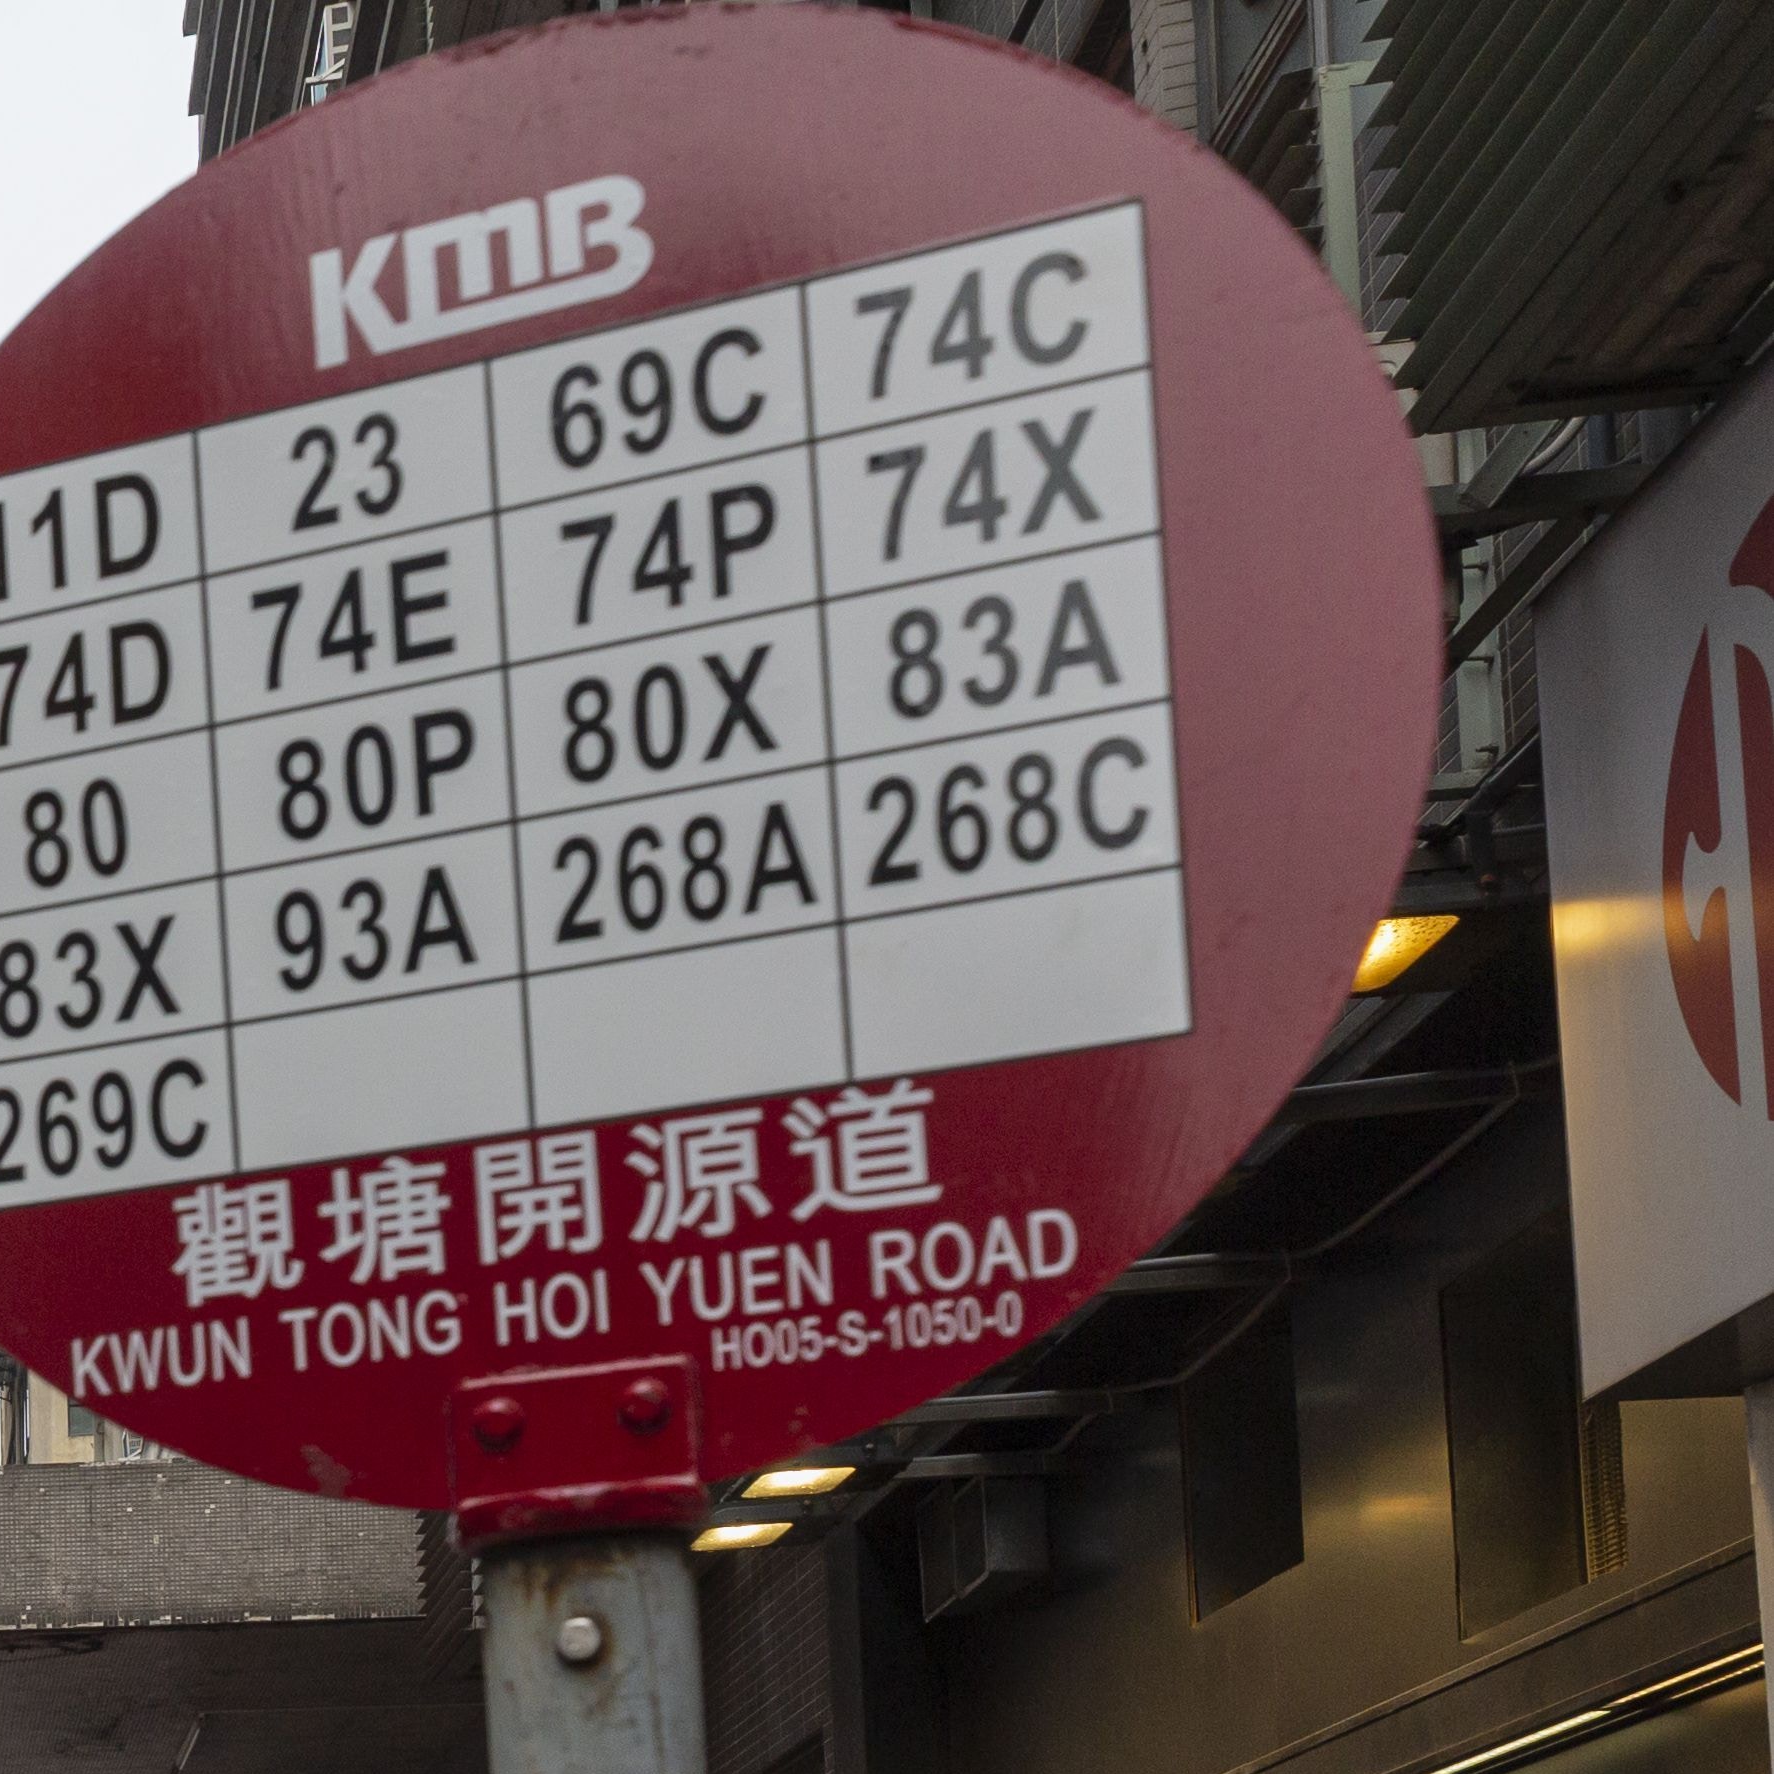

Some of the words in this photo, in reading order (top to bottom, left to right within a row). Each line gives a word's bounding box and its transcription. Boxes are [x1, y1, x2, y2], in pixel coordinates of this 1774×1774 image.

[309, 172, 655, 370] KMB
[854, 250, 1090, 403] 74C
[548, 327, 765, 470] 69C
[293, 412, 405, 535] 23
[868, 407, 1105, 563] 74X
[252, 550, 456, 693] 74E
[561, 482, 780, 626] 74P
[564, 643, 780, 784] 80X
[889, 577, 1123, 720] 83A
[24, 777, 127, 890] 80
[278, 709, 475, 840] 80P
[864, 735, 1147, 885] 268C
[276, 866, 477, 993] 93A
[553, 802, 817, 943] 268A
[172, 1081, 940, 1306] 觀塘開源道
[71, 1315, 252, 1400] KWUN
[278, 1287, 462, 1373] TONG
[496, 1272, 610, 1348] HOI
[637, 1240, 835, 1325] YUEN
[868, 1207, 1078, 1290] ROAD
